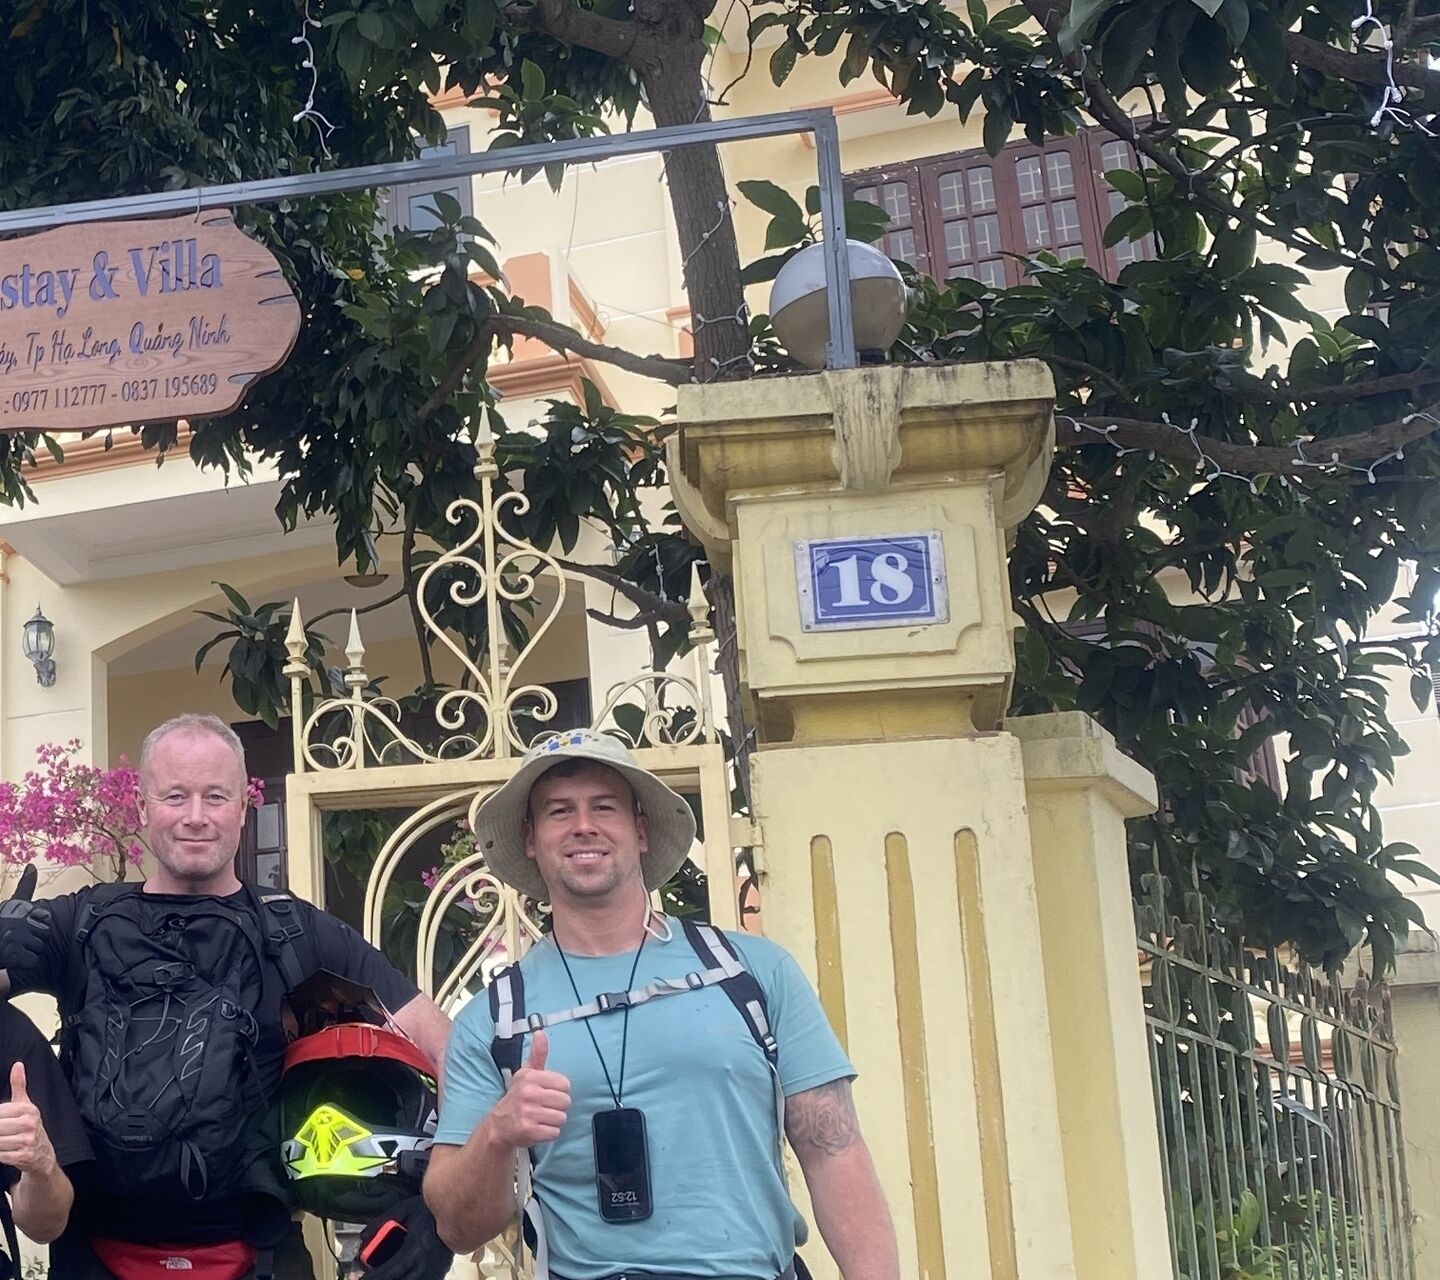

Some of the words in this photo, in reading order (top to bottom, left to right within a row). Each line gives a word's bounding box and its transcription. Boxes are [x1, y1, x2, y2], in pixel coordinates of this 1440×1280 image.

[88, 250, 120, 301] &
[127, 238, 223, 297] Villa
[26, 332, 45, 372] Tp
[50, 329, 75, 365] Hạ
[129, 321, 184, 359] Quảng
[189, 313, 231, 350] Ninh
[54, 384, 107, 408] 112777
[121, 379, 159, 402] 0837
[164, 373, 218, 399] 195689
[829, 552, 914, 607] 18
[611, 1191, 638, 1203] 12:52
